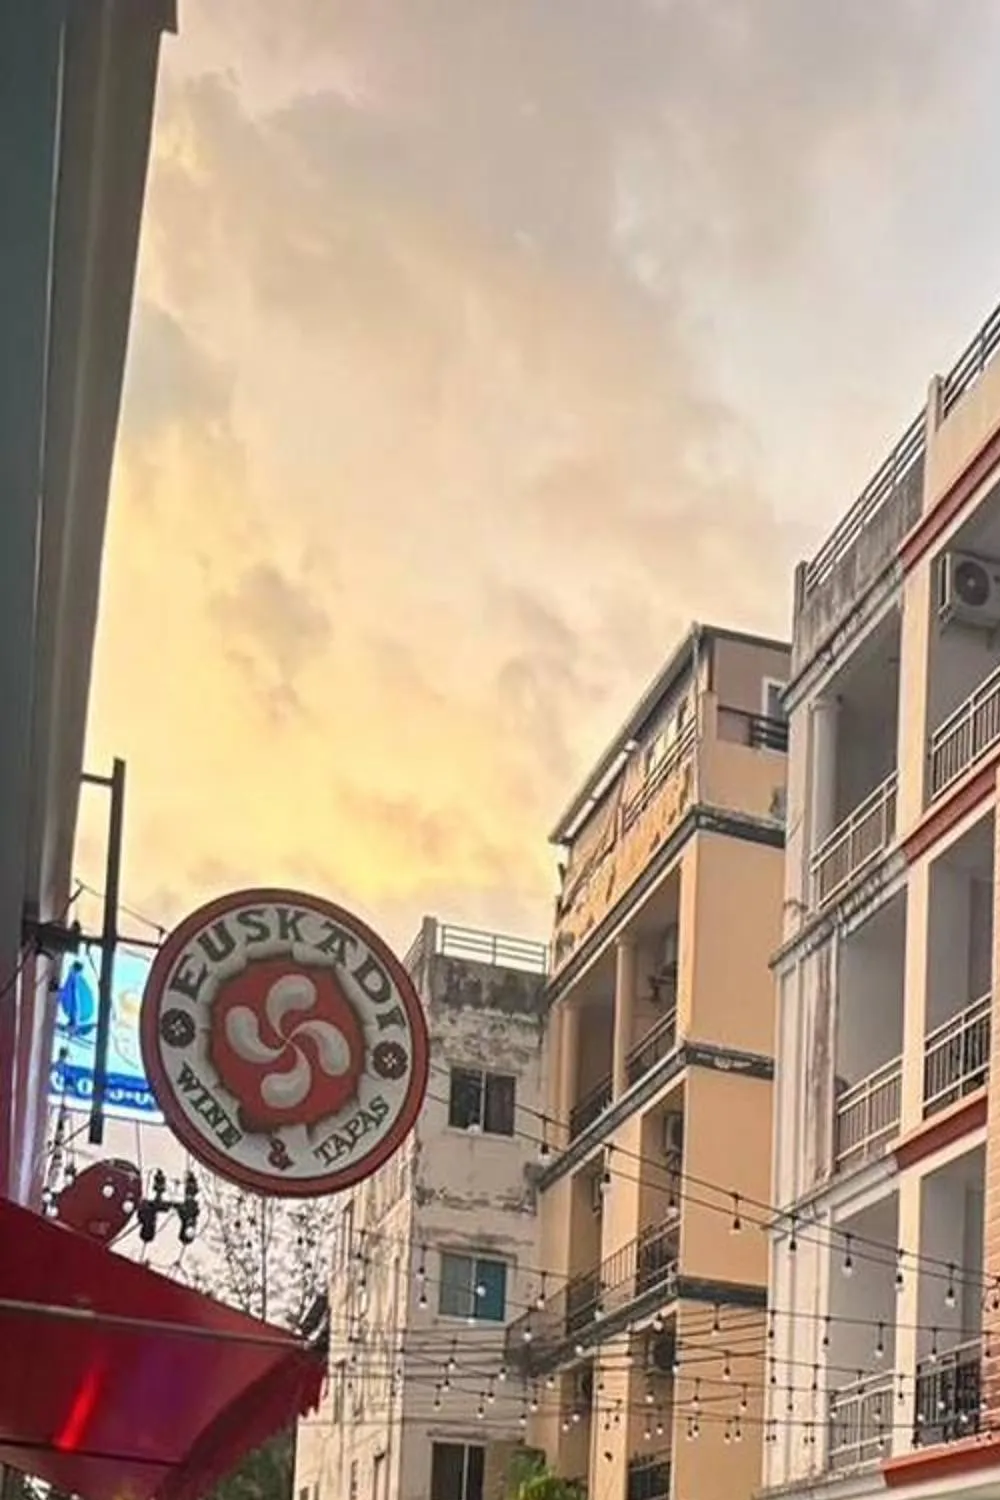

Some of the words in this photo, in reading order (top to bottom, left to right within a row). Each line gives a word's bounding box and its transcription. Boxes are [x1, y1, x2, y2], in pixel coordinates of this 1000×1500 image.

[170, 908, 407, 1032] EUSKADI
[177, 1063, 243, 1150] WINE
[267, 1138, 294, 1171] &
[313, 1095, 391, 1166] TAPAS
